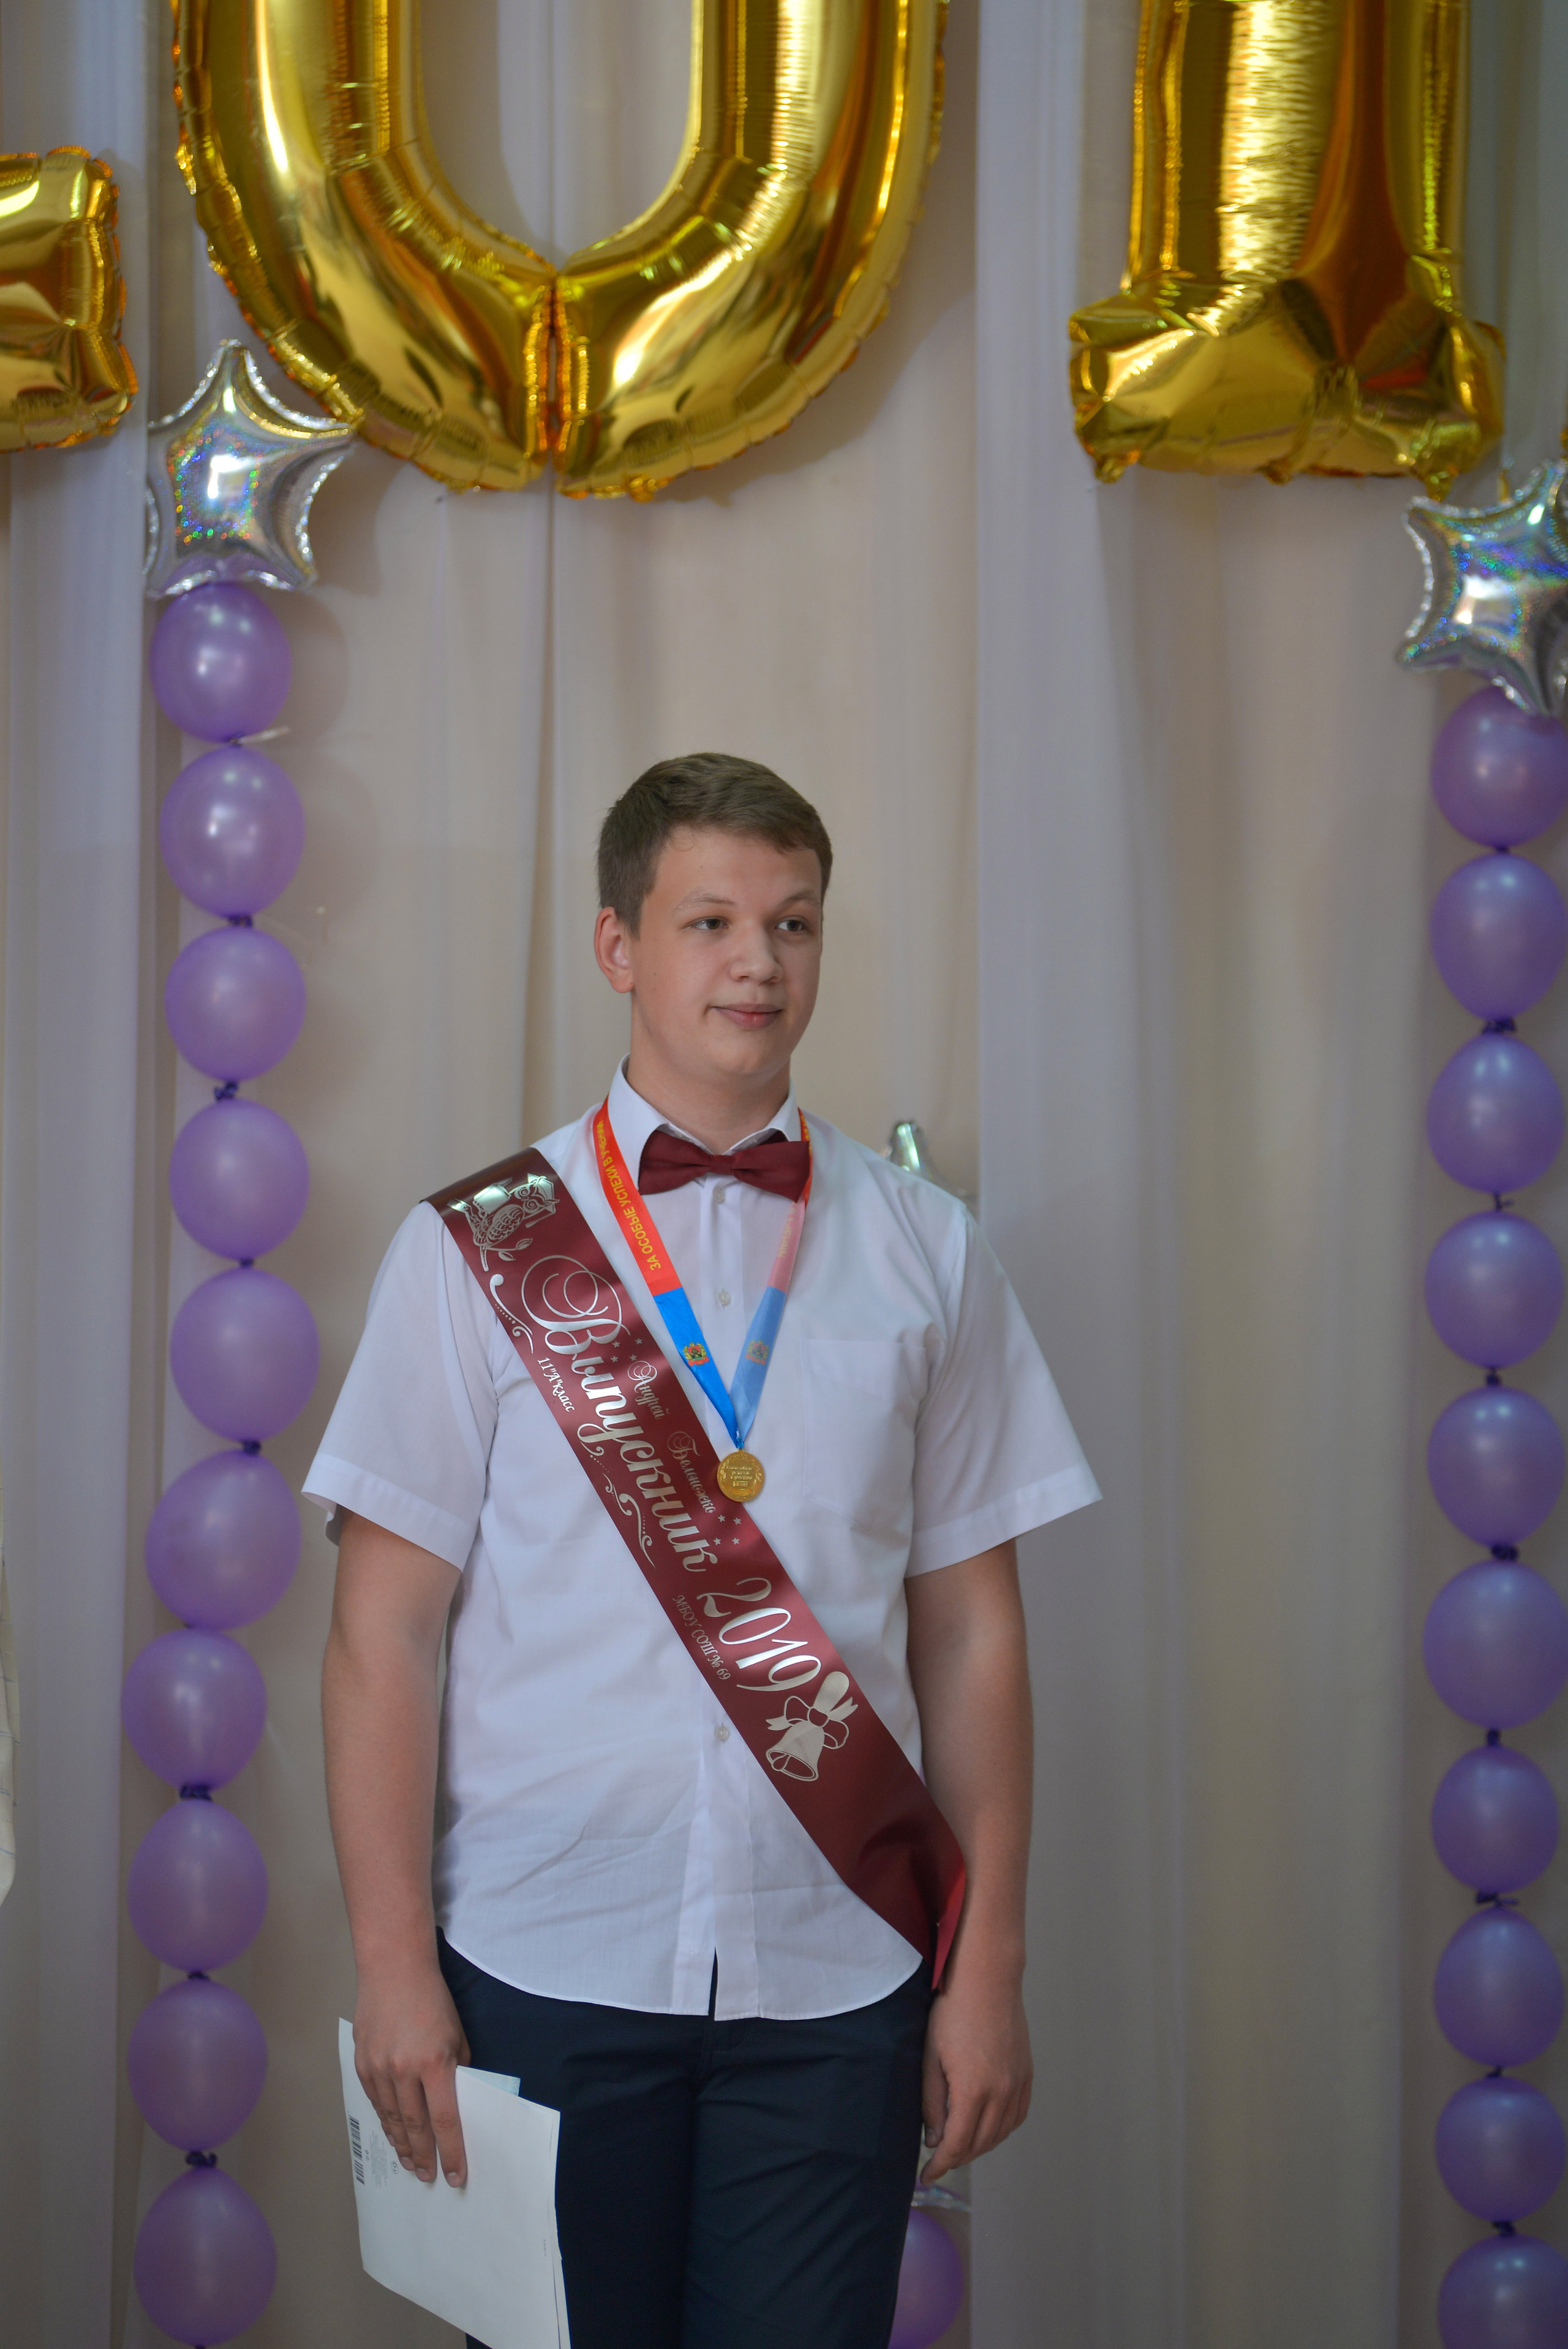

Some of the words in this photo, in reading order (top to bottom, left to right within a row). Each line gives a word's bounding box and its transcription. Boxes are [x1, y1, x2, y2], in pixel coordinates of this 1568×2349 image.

[603, 1156, 612, 1167] В
[606, 1165, 631, 1207] УСПЕХИ
[623, 1206, 653, 1254] ОСОБЫЕ
[647, 1254, 661, 1271] ЗА
[627, 1360, 669, 1420] Андрей
[521, 1255, 718, 1572] Выпускник
[697, 1578, 821, 1692] 2019
[673, 1595, 702, 1627] МБОУ
[692, 1630, 718, 1657] СОШ
[707, 1655, 723, 1668] №
[717, 1668, 731, 1680] 69
